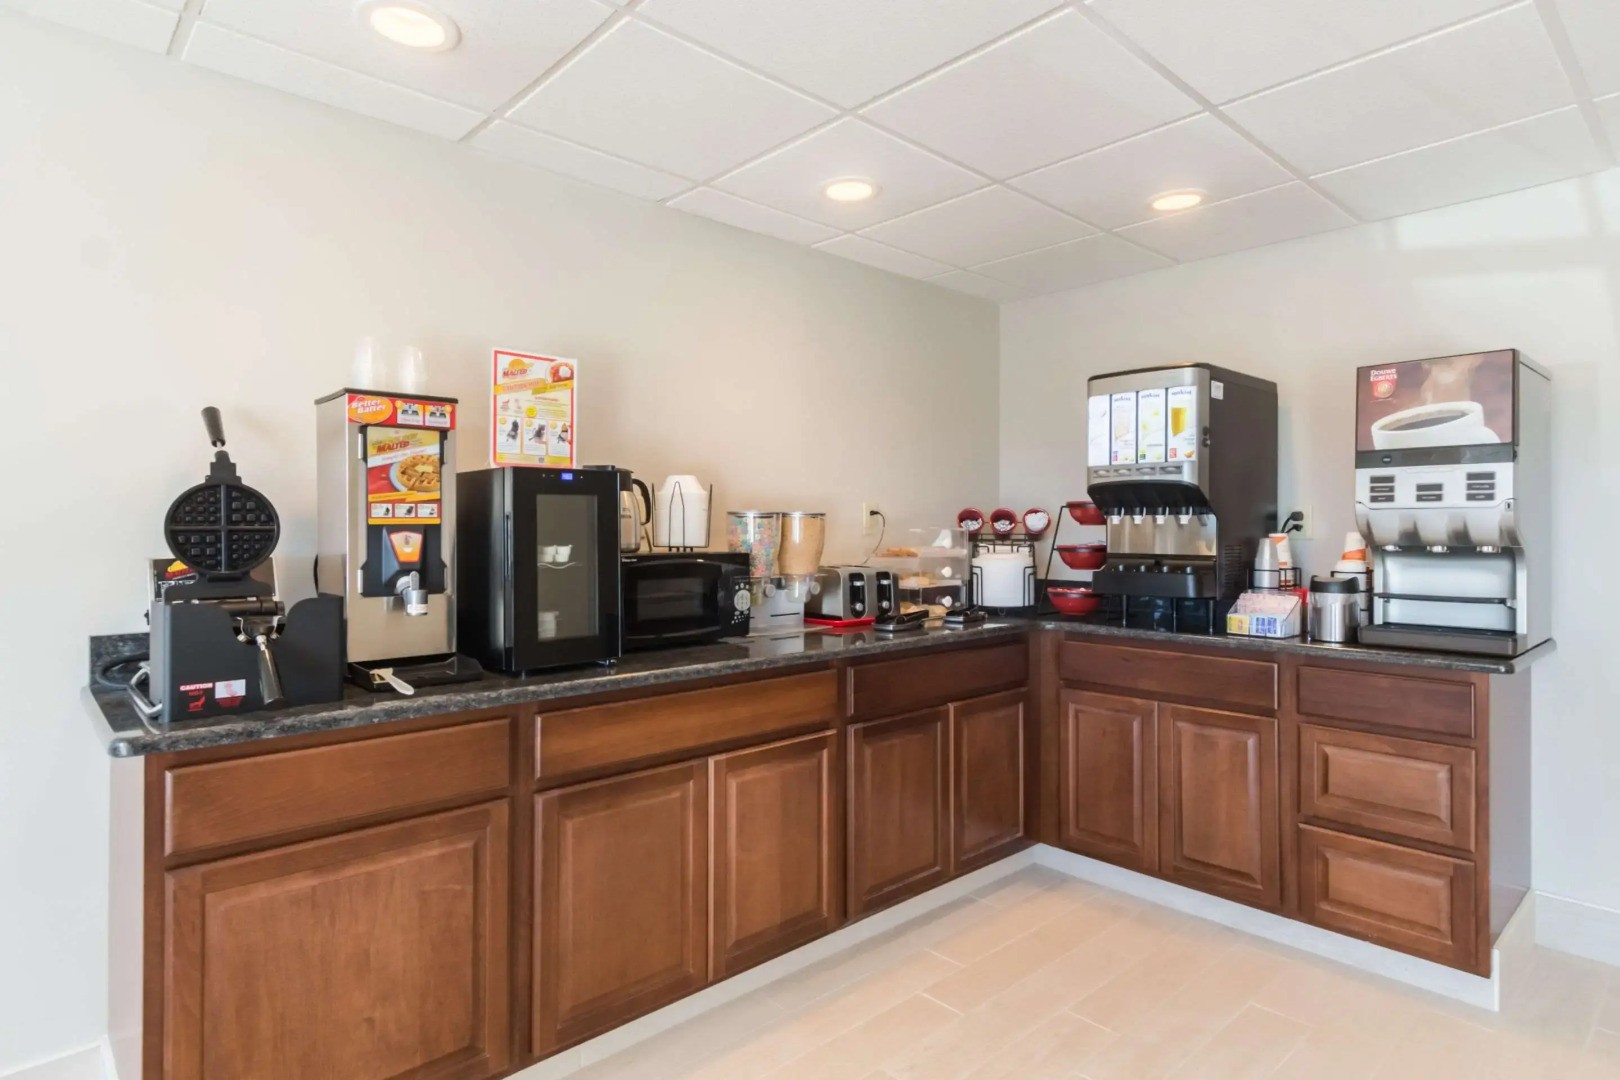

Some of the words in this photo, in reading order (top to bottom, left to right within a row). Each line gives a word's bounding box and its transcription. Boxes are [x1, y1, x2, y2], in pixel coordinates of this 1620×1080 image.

[351, 399, 381, 408] Better
[357, 404, 386, 414] Batter
[376, 440, 410, 453] MALTED
[179, 682, 213, 691] CAUTION
